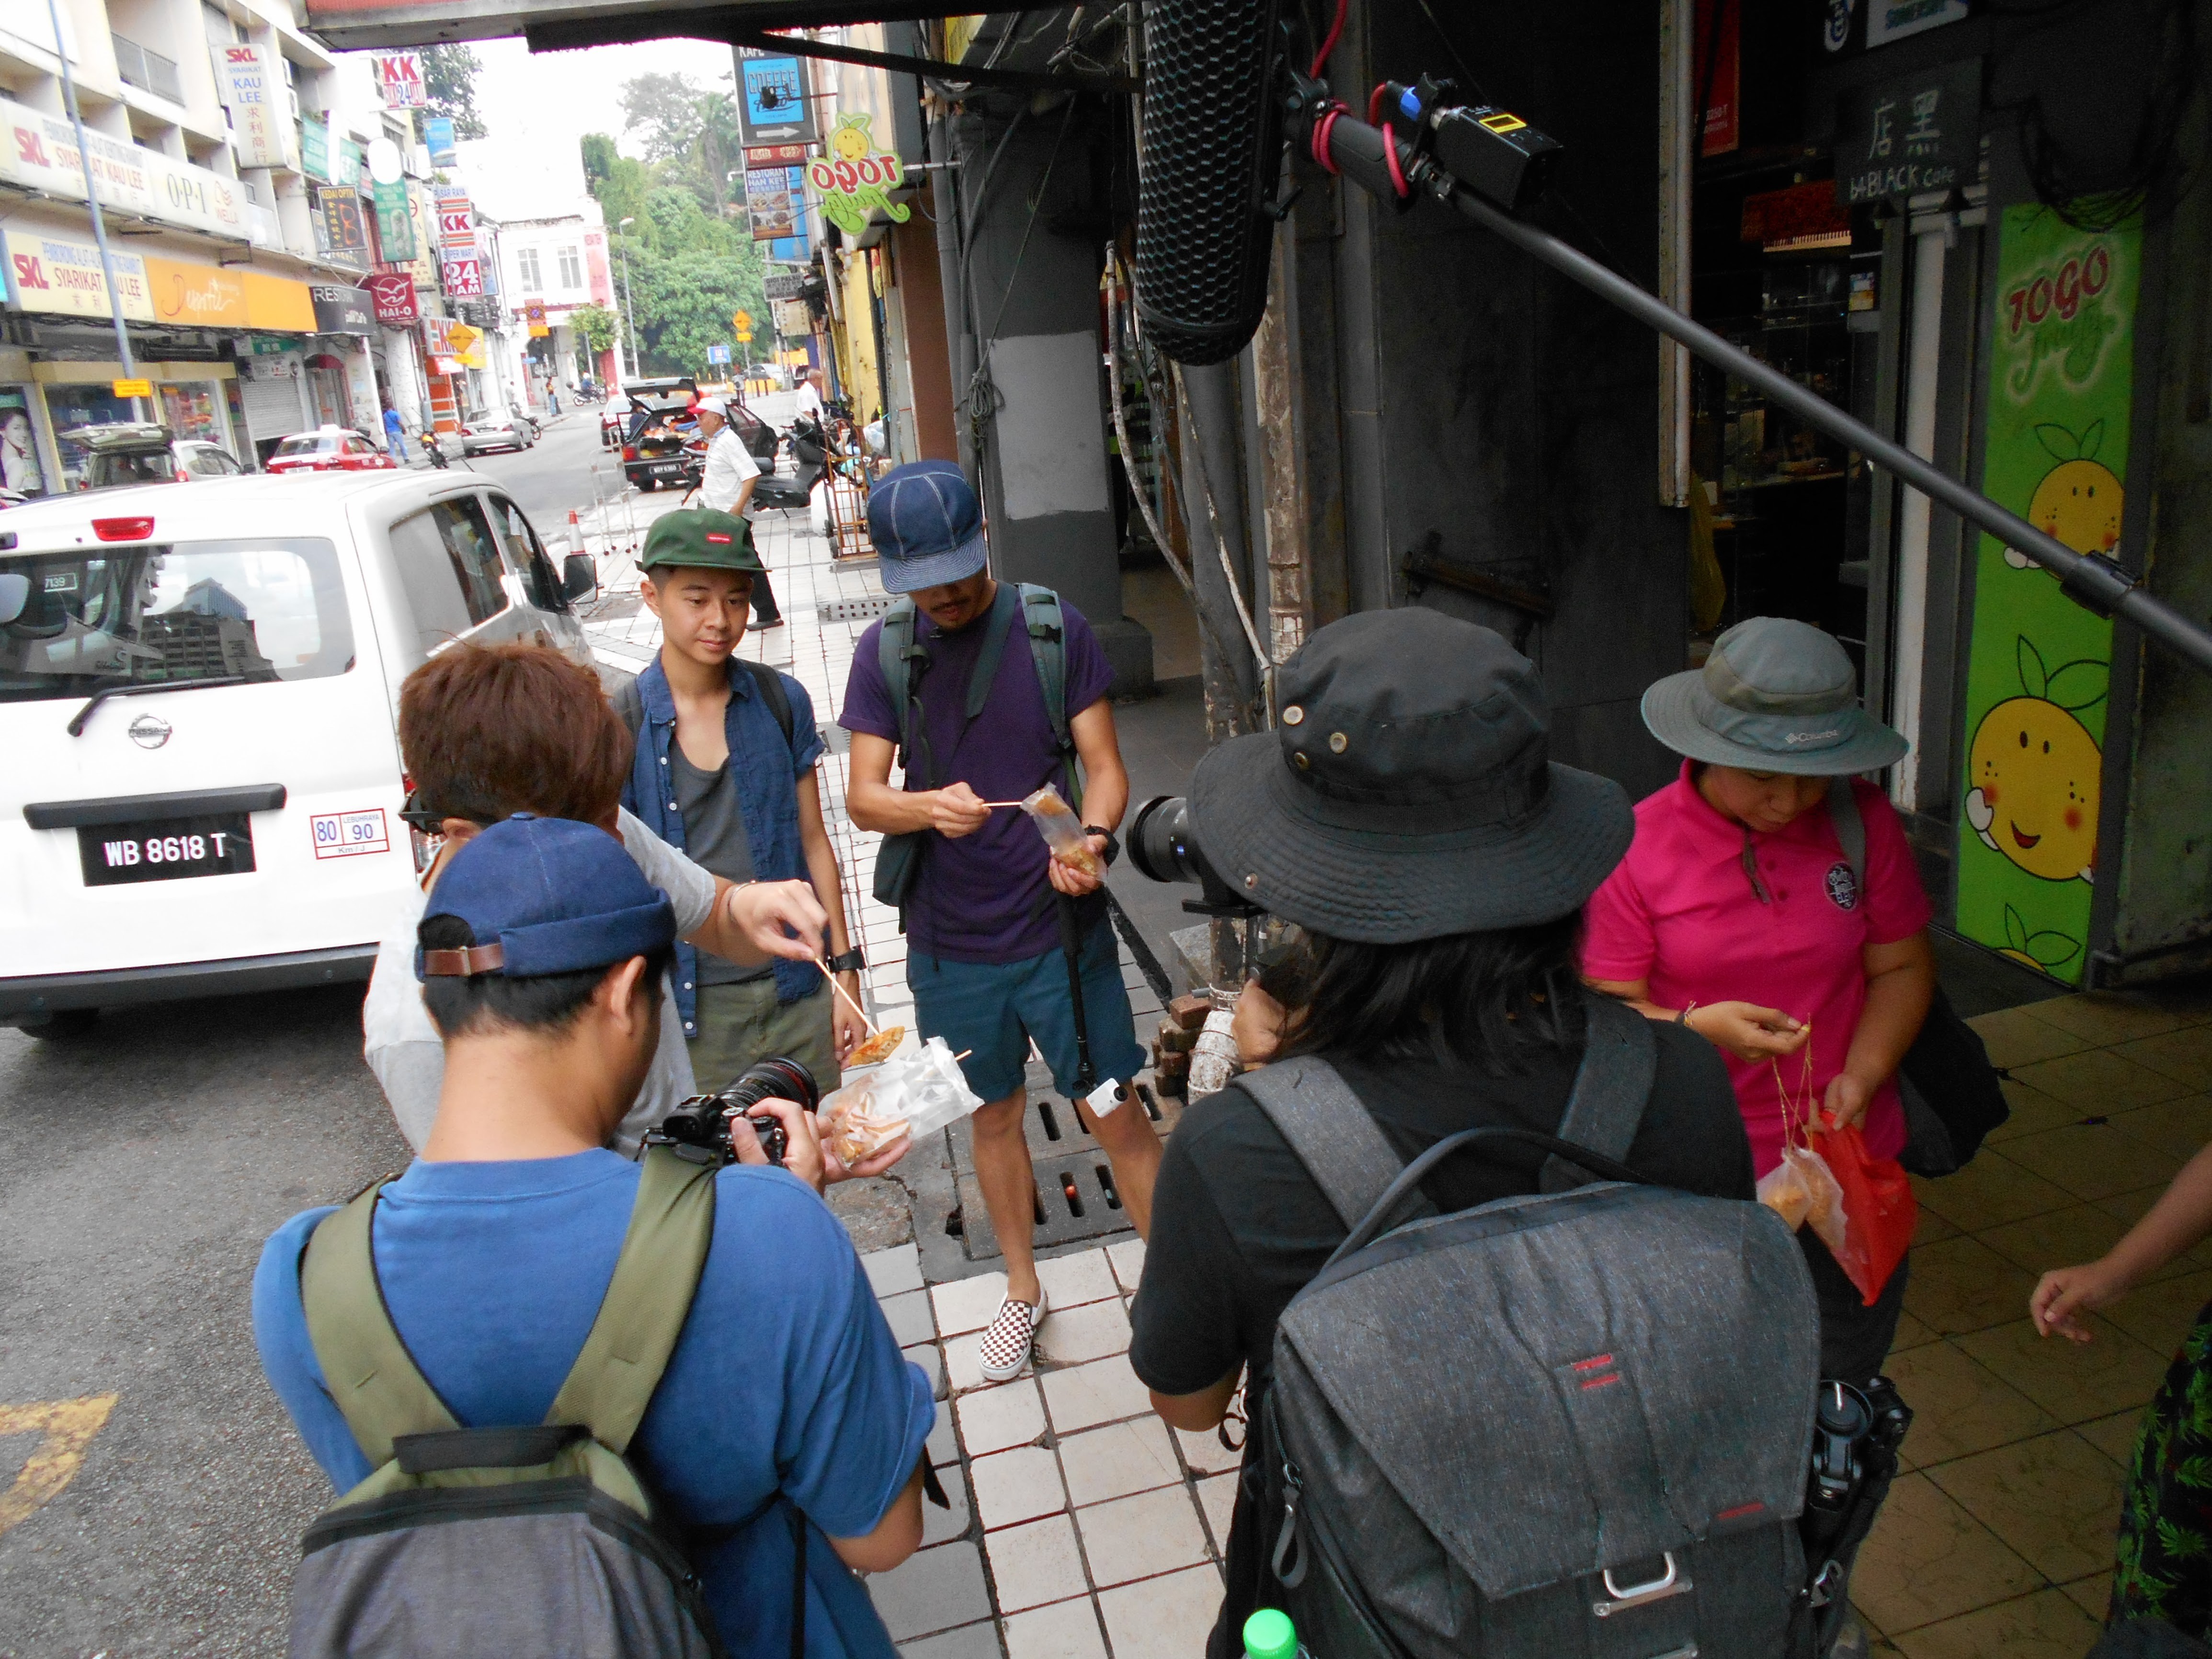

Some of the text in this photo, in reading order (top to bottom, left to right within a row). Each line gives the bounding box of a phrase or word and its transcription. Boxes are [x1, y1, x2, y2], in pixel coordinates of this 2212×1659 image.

[382, 56, 418, 82] KK
[233, 77, 262, 90] KAU
[238, 91, 262, 103] LEE
[55, 145, 104, 179] SYARAT
[126, 168, 145, 191] LEE
[747, 168, 785, 179] RESTORAN
[749, 177, 786, 187] HAN KEE
[433, 189, 452, 198] PSAR
[438, 214, 470, 232] KK
[461, 248, 475, 258] MART
[445, 261, 479, 286] 24
[54, 267, 103, 292] SYARIKAT
[124, 277, 141, 297] LEE
[449, 284, 481, 296] AM
[343, 814, 380, 823] LEBUHRAYA
[317, 820, 337, 842] 80
[353, 824, 374, 841] 90
[104, 833, 227, 867] WB 8618 T
